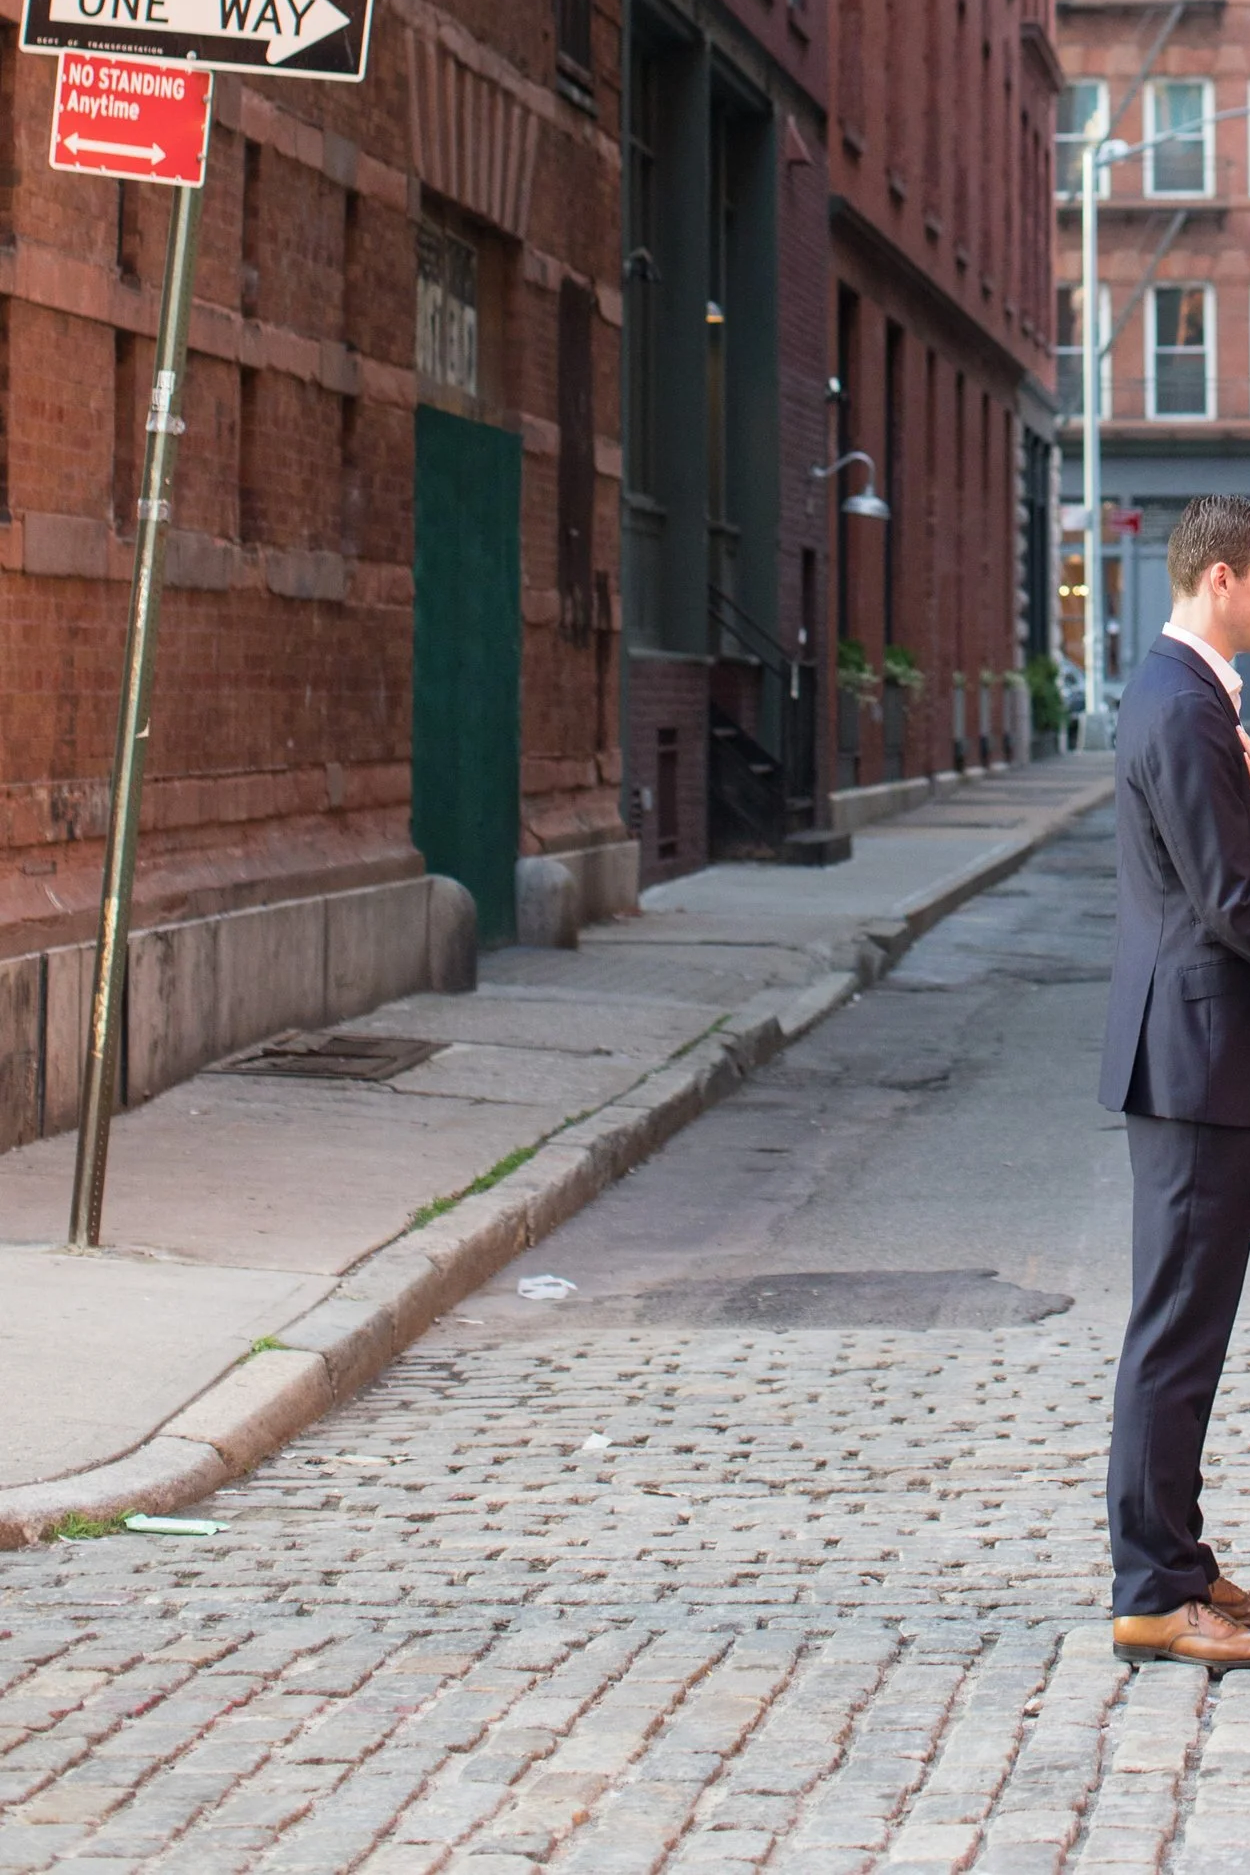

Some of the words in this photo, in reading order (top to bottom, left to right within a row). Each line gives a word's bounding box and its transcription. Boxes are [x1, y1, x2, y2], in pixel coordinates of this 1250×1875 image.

[87, 41, 164, 55] TRANSPORTATION
[68, 63, 95, 88] NO
[98, 67, 186, 101] STANDING
[66, 90, 141, 121] Anytime
